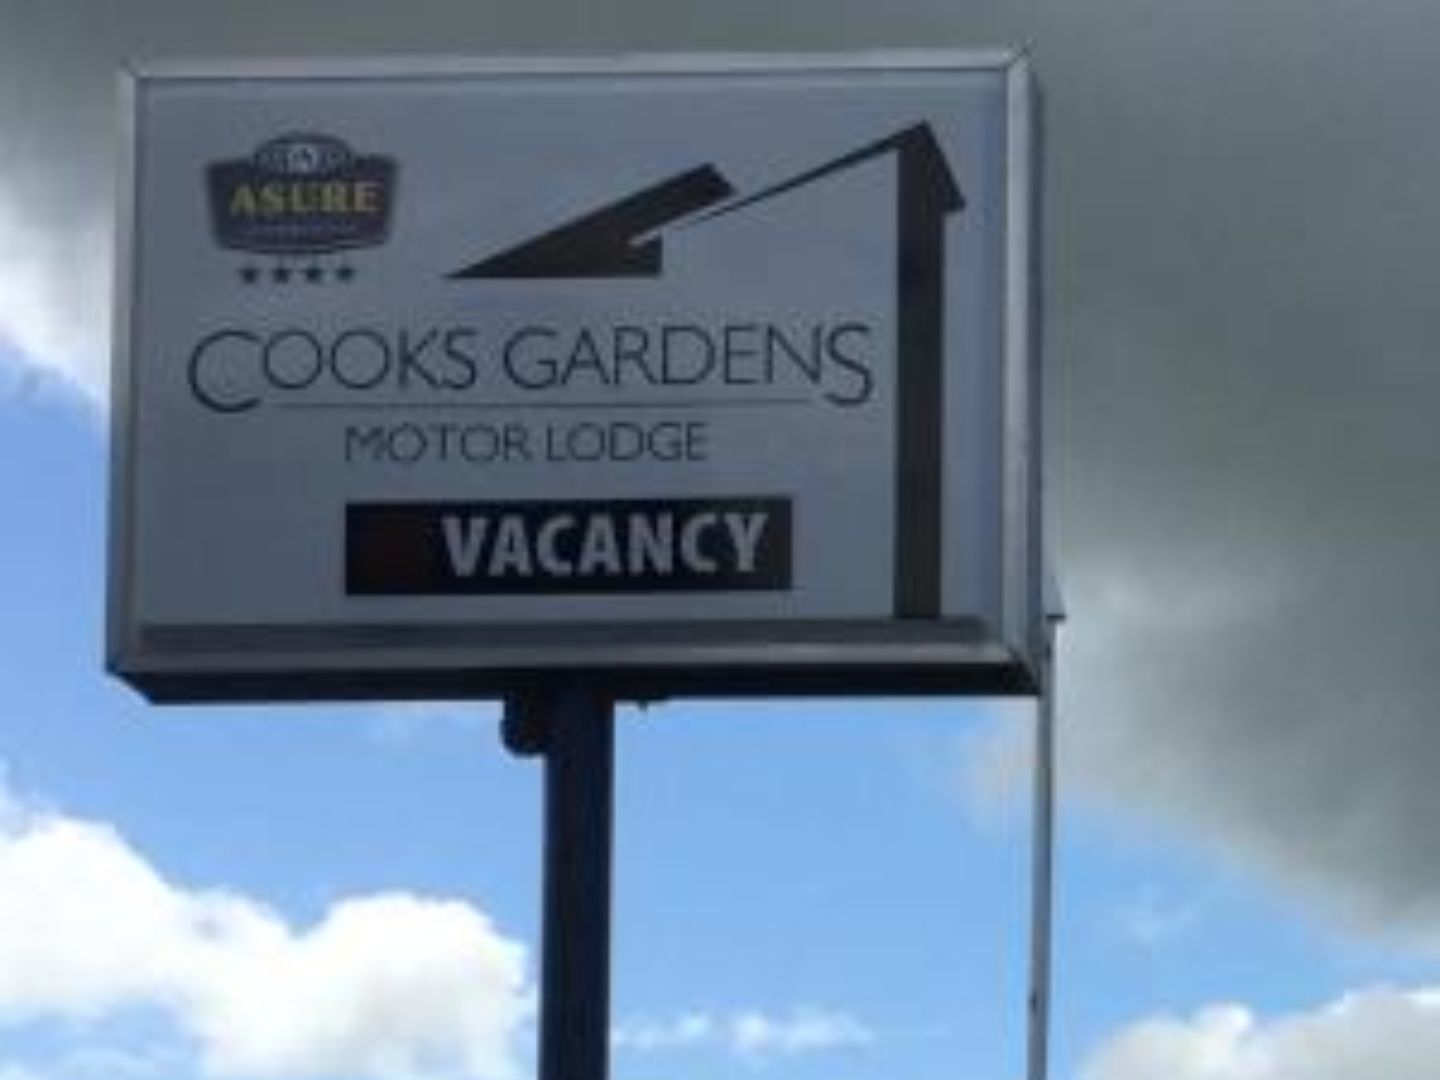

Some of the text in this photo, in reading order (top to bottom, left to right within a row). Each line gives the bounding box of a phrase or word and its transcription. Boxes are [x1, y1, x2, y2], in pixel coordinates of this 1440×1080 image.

[187, 323, 874, 413] COOKS GARDENS
[344, 421, 708, 462] MOTOR LODGE
[440, 512, 769, 577] VACANCY
